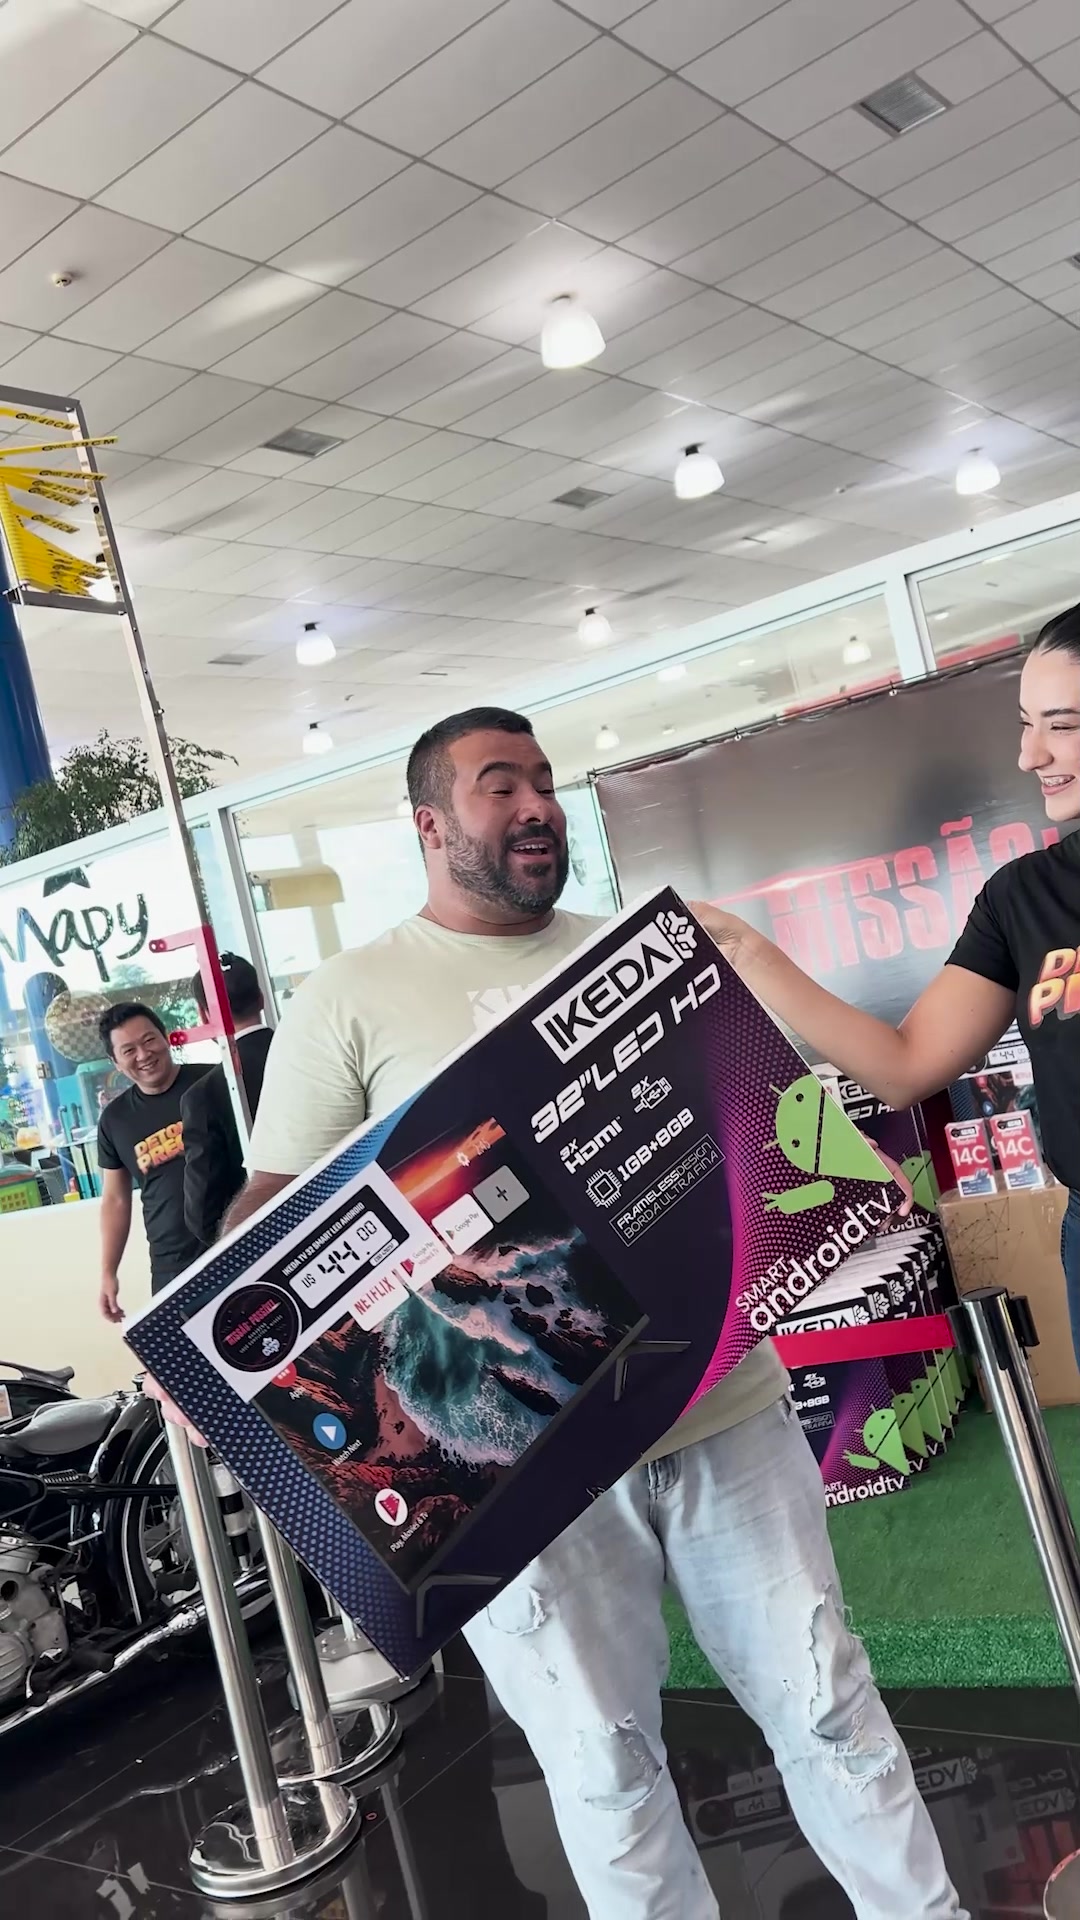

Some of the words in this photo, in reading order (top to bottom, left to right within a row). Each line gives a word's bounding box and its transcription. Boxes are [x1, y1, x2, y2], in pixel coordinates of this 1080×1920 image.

[543, 942, 675, 1052] IKEDA
[669, 962, 721, 1025] HD
[617, 1107, 695, 1182] 1GB+8GB
[951, 1145, 988, 1167] 14C
[997, 1136, 1034, 1159] 14C
[623, 1202, 663, 1239] BORDA
[661, 1174, 696, 1206] ULTRA
[354, 1276, 396, 1316] NETFLIX
[735, 1256, 790, 1313] SMART
